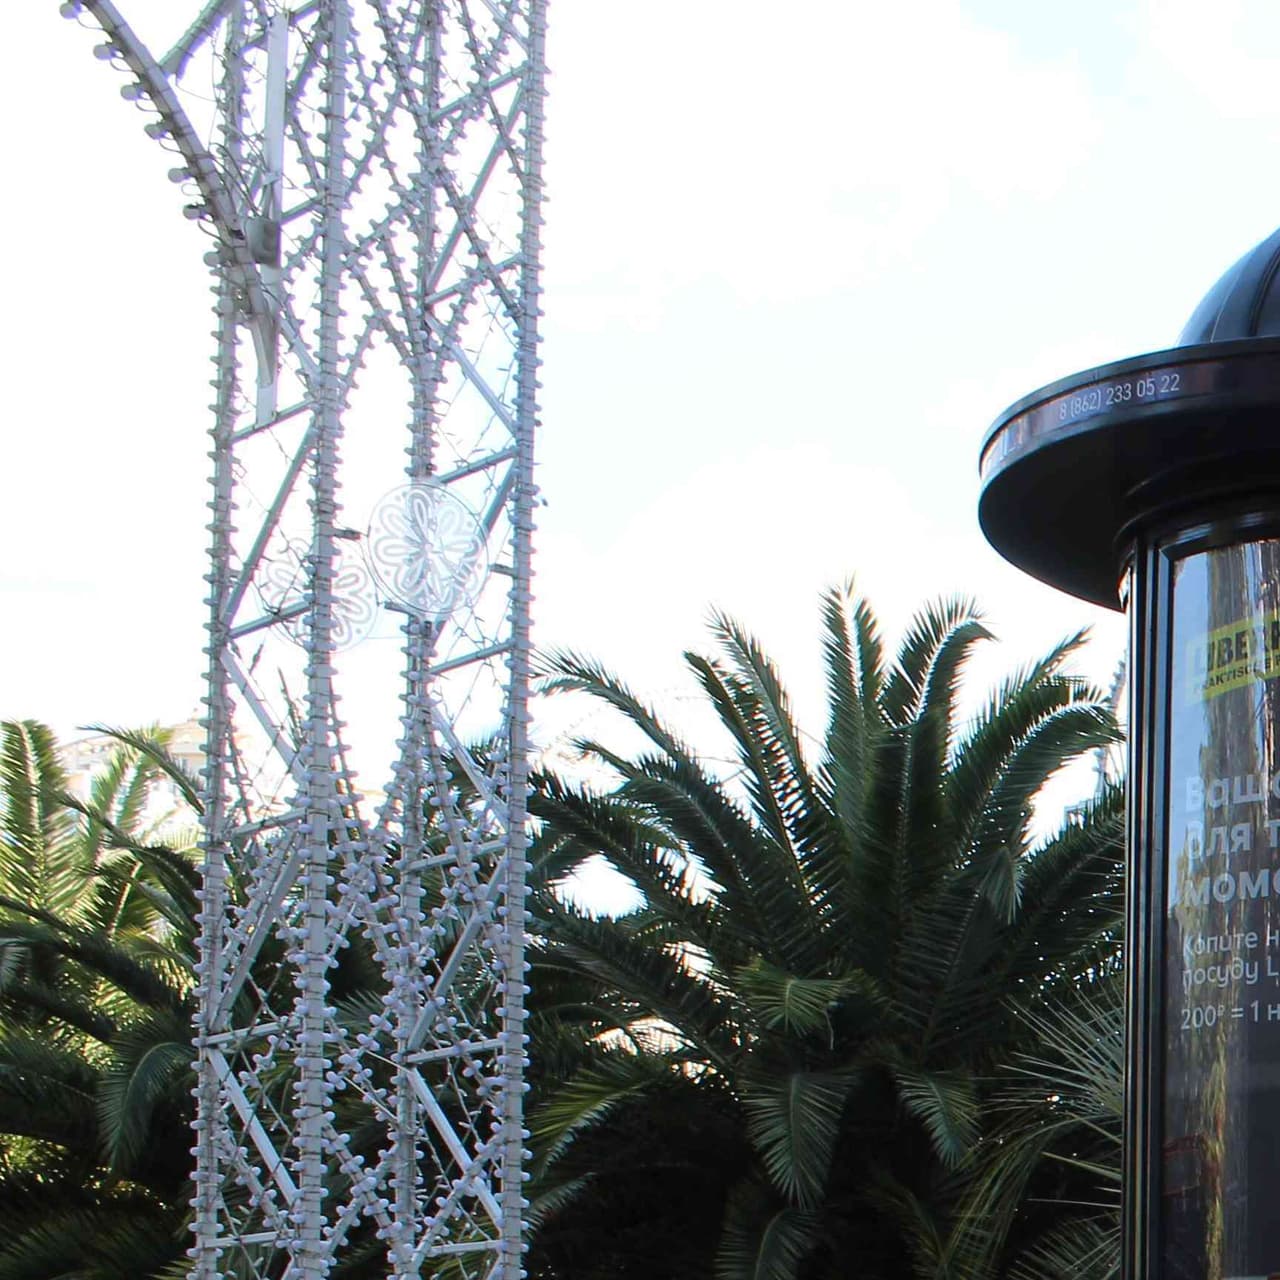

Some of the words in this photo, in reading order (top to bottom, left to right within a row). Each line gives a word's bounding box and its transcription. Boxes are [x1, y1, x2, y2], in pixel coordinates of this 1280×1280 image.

[1058, 402, 1067, 420] 8
[1070, 390, 1102, 418] (862)
[1106, 385, 1132, 406] 233
[1136, 377, 1156, 399] 05
[1160, 373, 1182, 394] 22
[1185, 818, 1253, 863] для
[1182, 931, 1259, 957] Копите
[1182, 956, 1259, 987] посуду
[1250, 1001, 1259, 1022] 1
